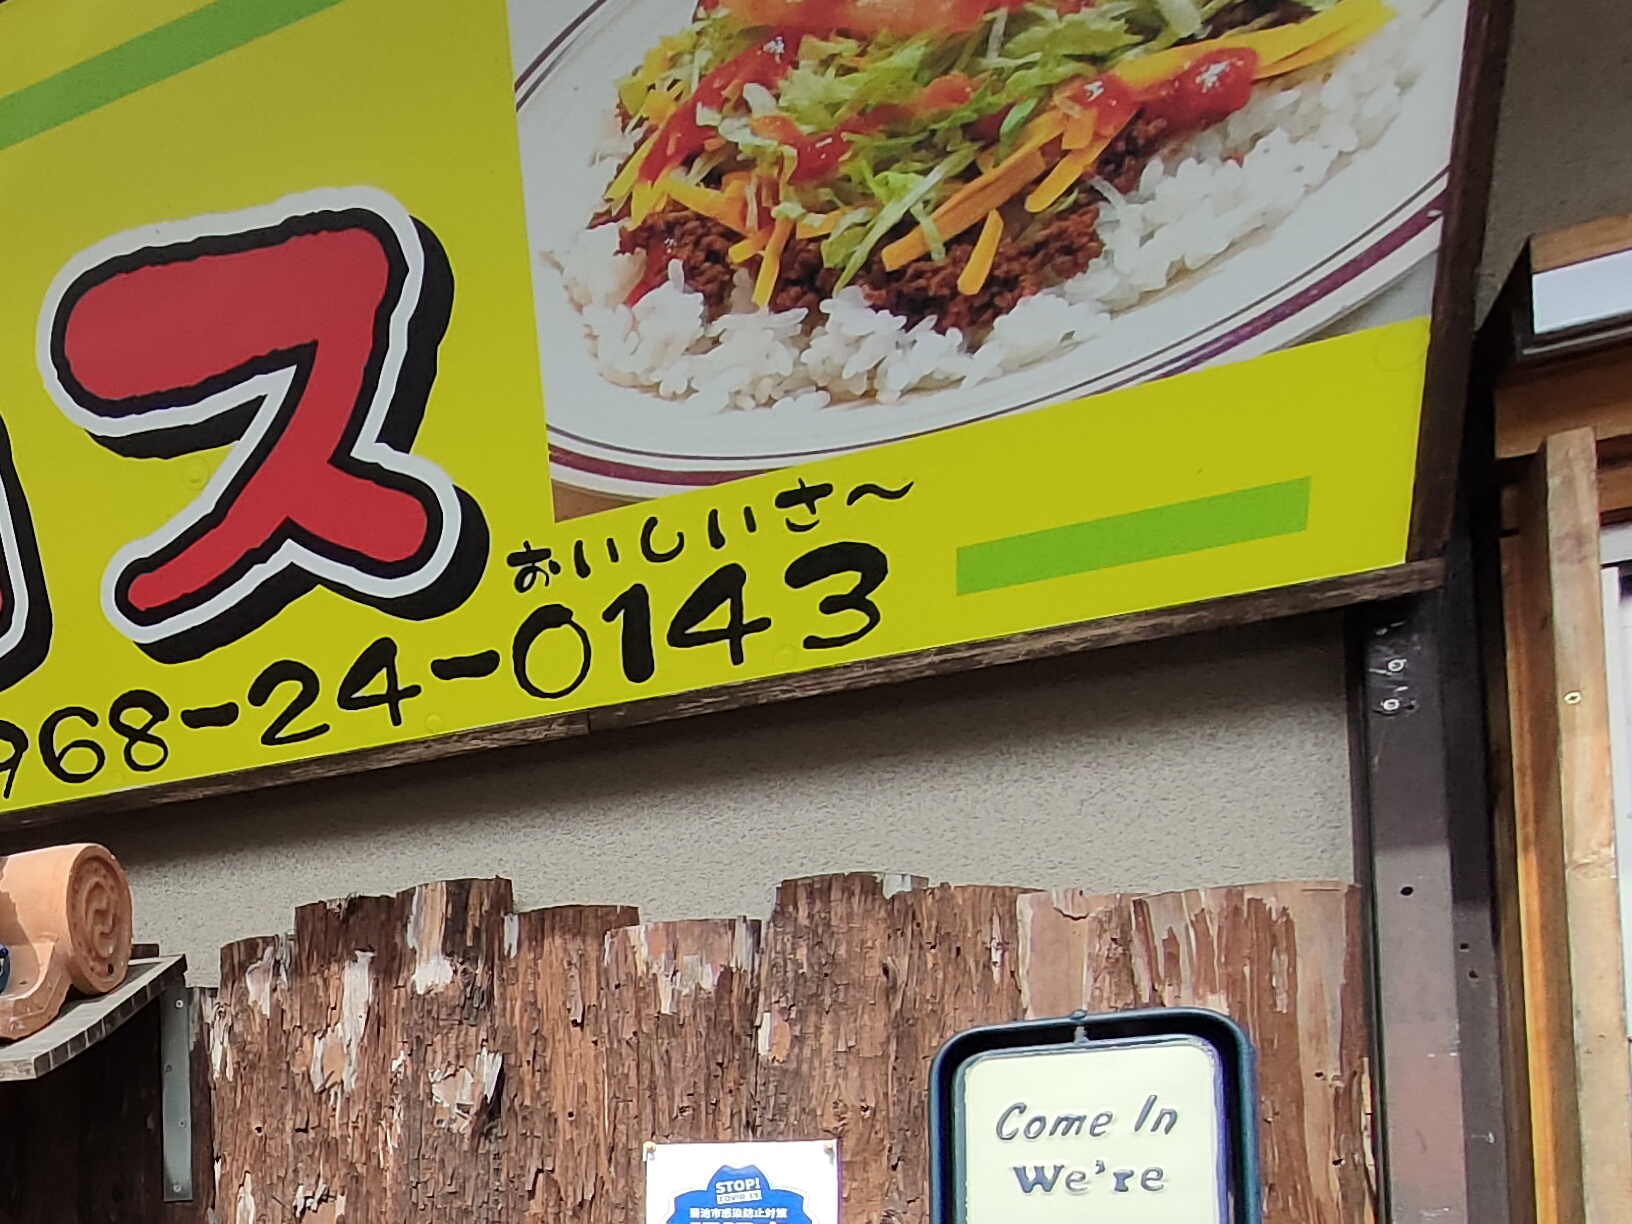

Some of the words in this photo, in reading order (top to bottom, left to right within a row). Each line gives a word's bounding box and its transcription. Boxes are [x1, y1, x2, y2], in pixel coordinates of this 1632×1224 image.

[996, 1102, 1113, 1140] Come
[1134, 1094, 1178, 1135] In
[715, 1177, 761, 1194] STOP!
[1012, 1159, 1165, 1194] We're
[718, 1192, 760, 1202] COVID-19
